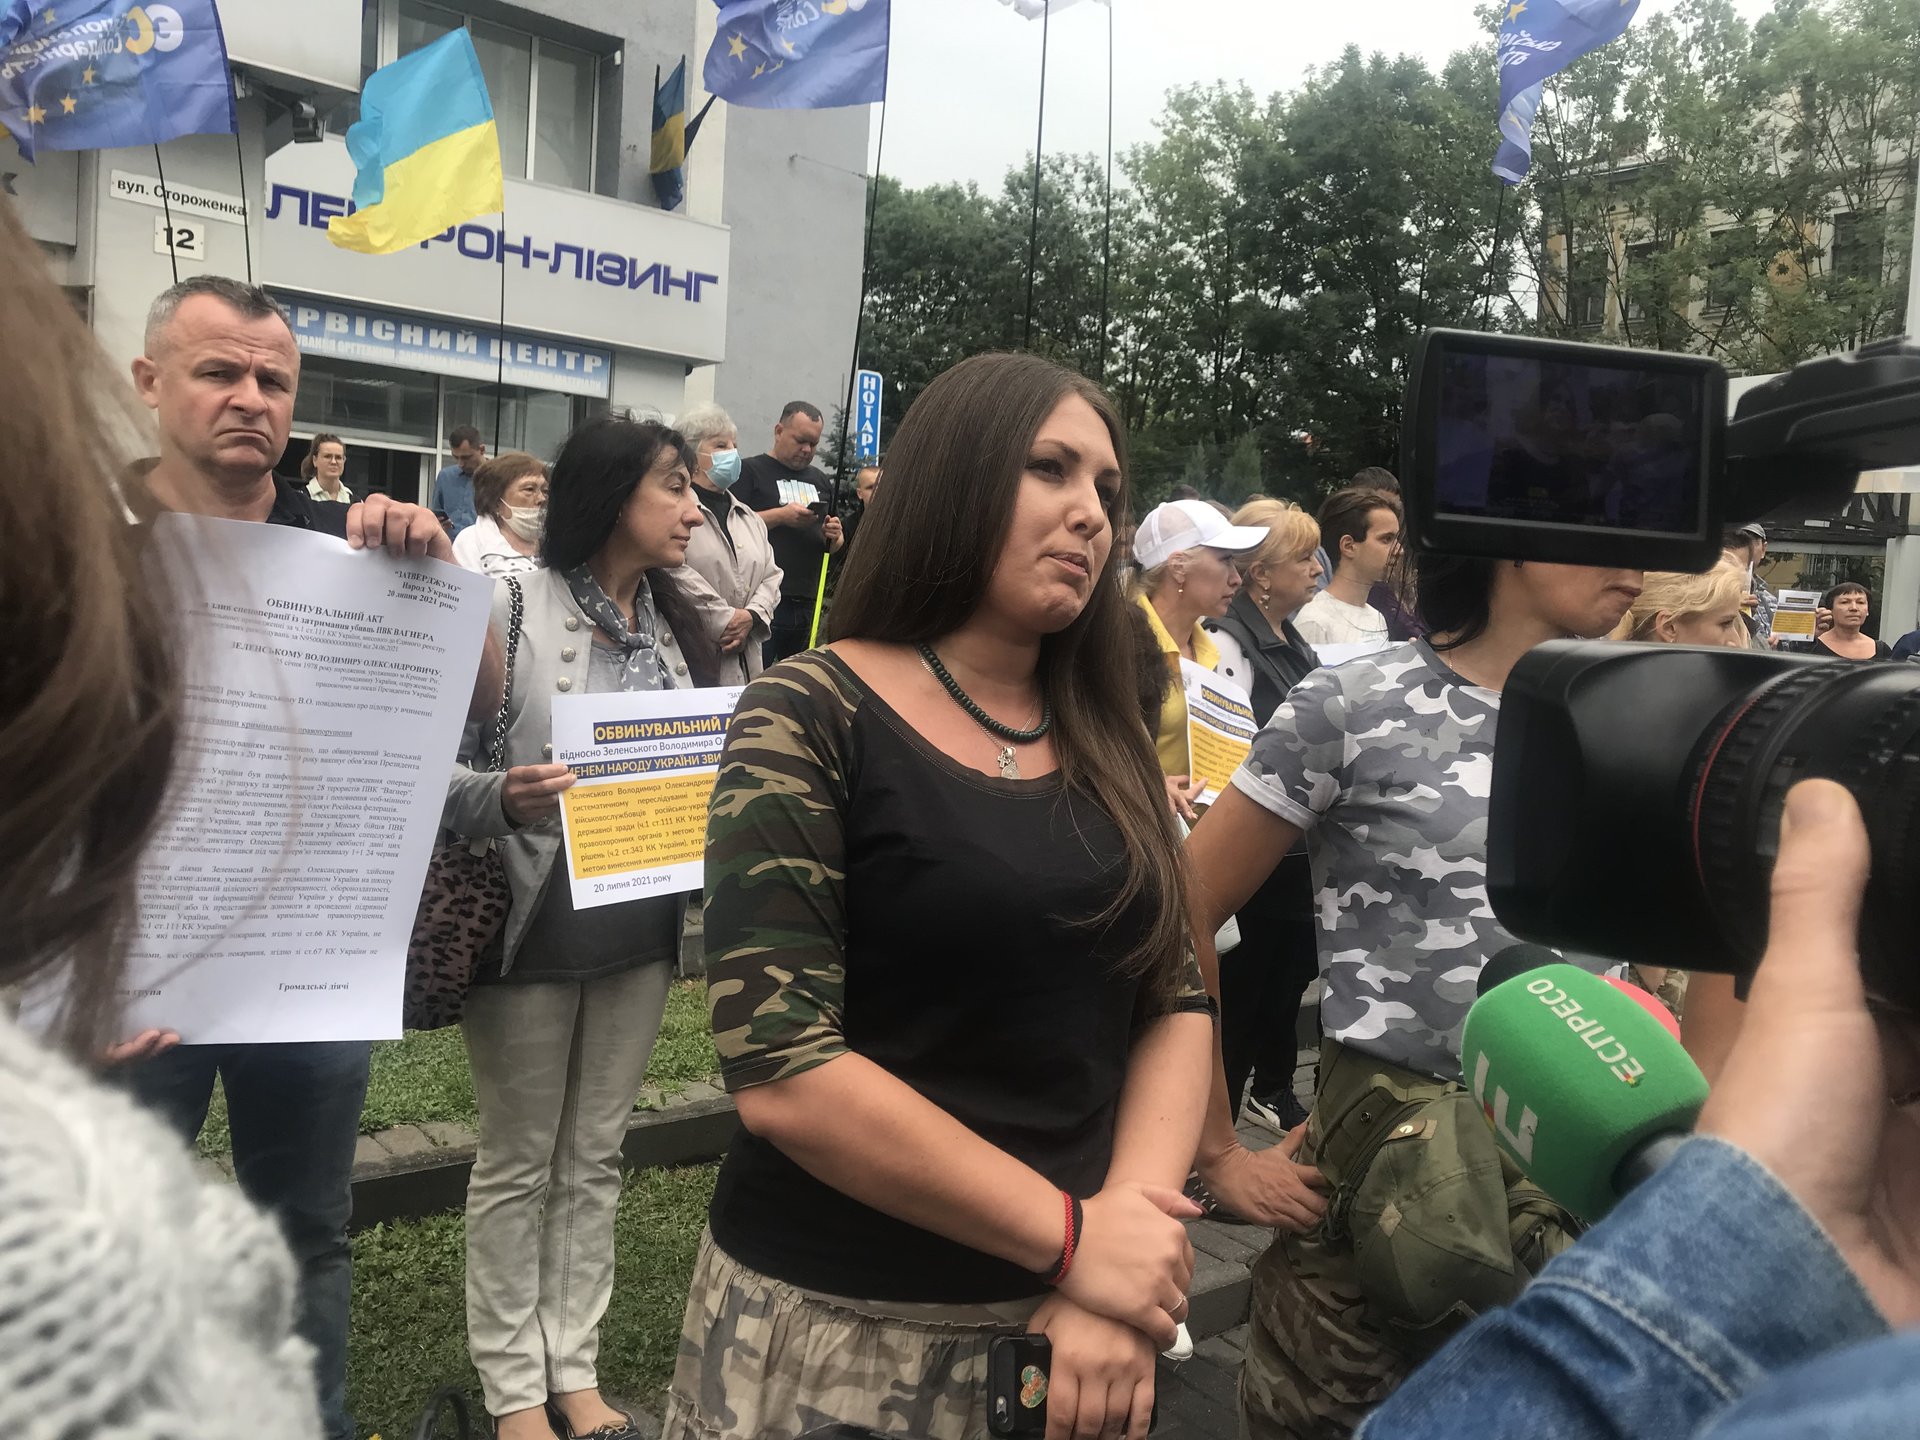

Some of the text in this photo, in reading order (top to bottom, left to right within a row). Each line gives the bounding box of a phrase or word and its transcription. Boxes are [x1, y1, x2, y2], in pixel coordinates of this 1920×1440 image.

[117, 180, 246, 216] вул. Стороженка
[163, 226, 195, 251] 12
[489, 338, 602, 373] ЦЕНТР
[402, 581, 460, 602] Народ України
[266, 598, 364, 621] ОБВИНУВАЛЬНИЙ
[366, 615, 384, 623] АКТ
[419, 595, 437, 605] 2021
[439, 600, 457, 612] року
[301, 616, 349, 630] затримання
[376, 626, 393, 635] ПВК
[393, 629, 434, 642] ВАГНЕРА
[303, 662, 318, 670] 1978
[305, 653, 362, 666] ВОЛОДИМИРУ
[363, 660, 443, 678] ОЛЕКСАНДРОВИЧУ,
[226, 689, 246, 698] року
[411, 690, 437, 700] України
[594, 716, 722, 741] ОБВИНУВАЛЬНИЙ
[382, 750, 422, 761] Зеленський
[560, 749, 602, 760] відносно
[603, 744, 658, 756] Зеленського
[659, 740, 714, 752] Володимира
[247, 750, 256, 758] 20
[379, 759, 421, 770] Президента
[607, 760, 652, 775] НАРОДУ
[654, 754, 700, 769] УКРАЇНИ
[211, 767, 244, 777] України
[361, 785, 378, 793] ПВК
[570, 790, 613, 800] Зеленського
[617, 784, 661, 795] Володимира
[572, 801, 629, 812] систематичному
[637, 793, 688, 805] переслідуванні
[575, 810, 646, 825] військовослужбовців
[250, 828, 282, 837] секретна
[388, 823, 405, 832] ПВК
[577, 827, 613, 838] державної
[615, 824, 635, 833] зради
[652, 817, 673, 828] ст.111
[675, 815, 686, 824] КК
[579, 836, 635, 850] правоохоронних
[637, 832, 663, 843] органів
[672, 827, 695, 836] метою
[580, 852, 605, 862] рішень
[622, 846, 644, 856] ст.343
[659, 838, 689, 850] України),
[582, 865, 606, 873] метою
[607, 859, 642, 870] винесення
[643, 857, 661, 865] ними
[332, 875, 360, 883] України
[593, 873, 672, 893] 20 липня 2021 року
[298, 893, 326, 902] України
[177, 913, 211, 922] України,
[181, 922, 195, 930] КК
[326, 929, 338, 937] КК
[341, 929, 370, 938] України,
[303, 948, 322, 956] ст.67
[325, 947, 337, 955] КК
[339, 947, 367, 956] України
[278, 982, 327, 992] Громадські
[1526, 978, 1647, 1083] ЕСПРЕСО
